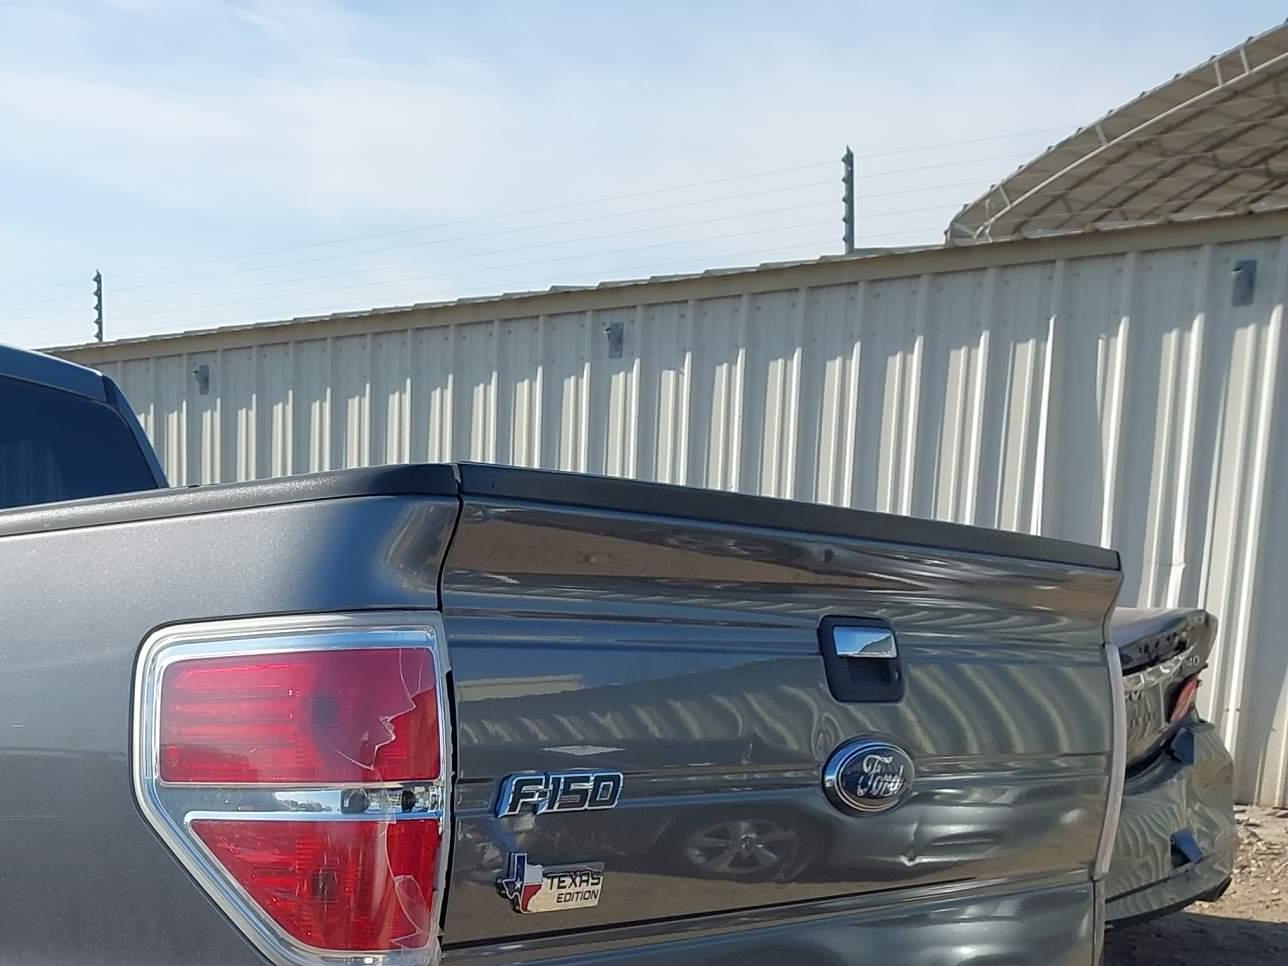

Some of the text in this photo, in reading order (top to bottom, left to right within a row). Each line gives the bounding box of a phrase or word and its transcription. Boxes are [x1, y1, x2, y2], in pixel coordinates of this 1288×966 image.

[857, 754, 904, 797] Ford
[498, 771, 623, 818] F-150
[547, 871, 601, 891] TEXAS
[556, 889, 599, 904] EDITION
